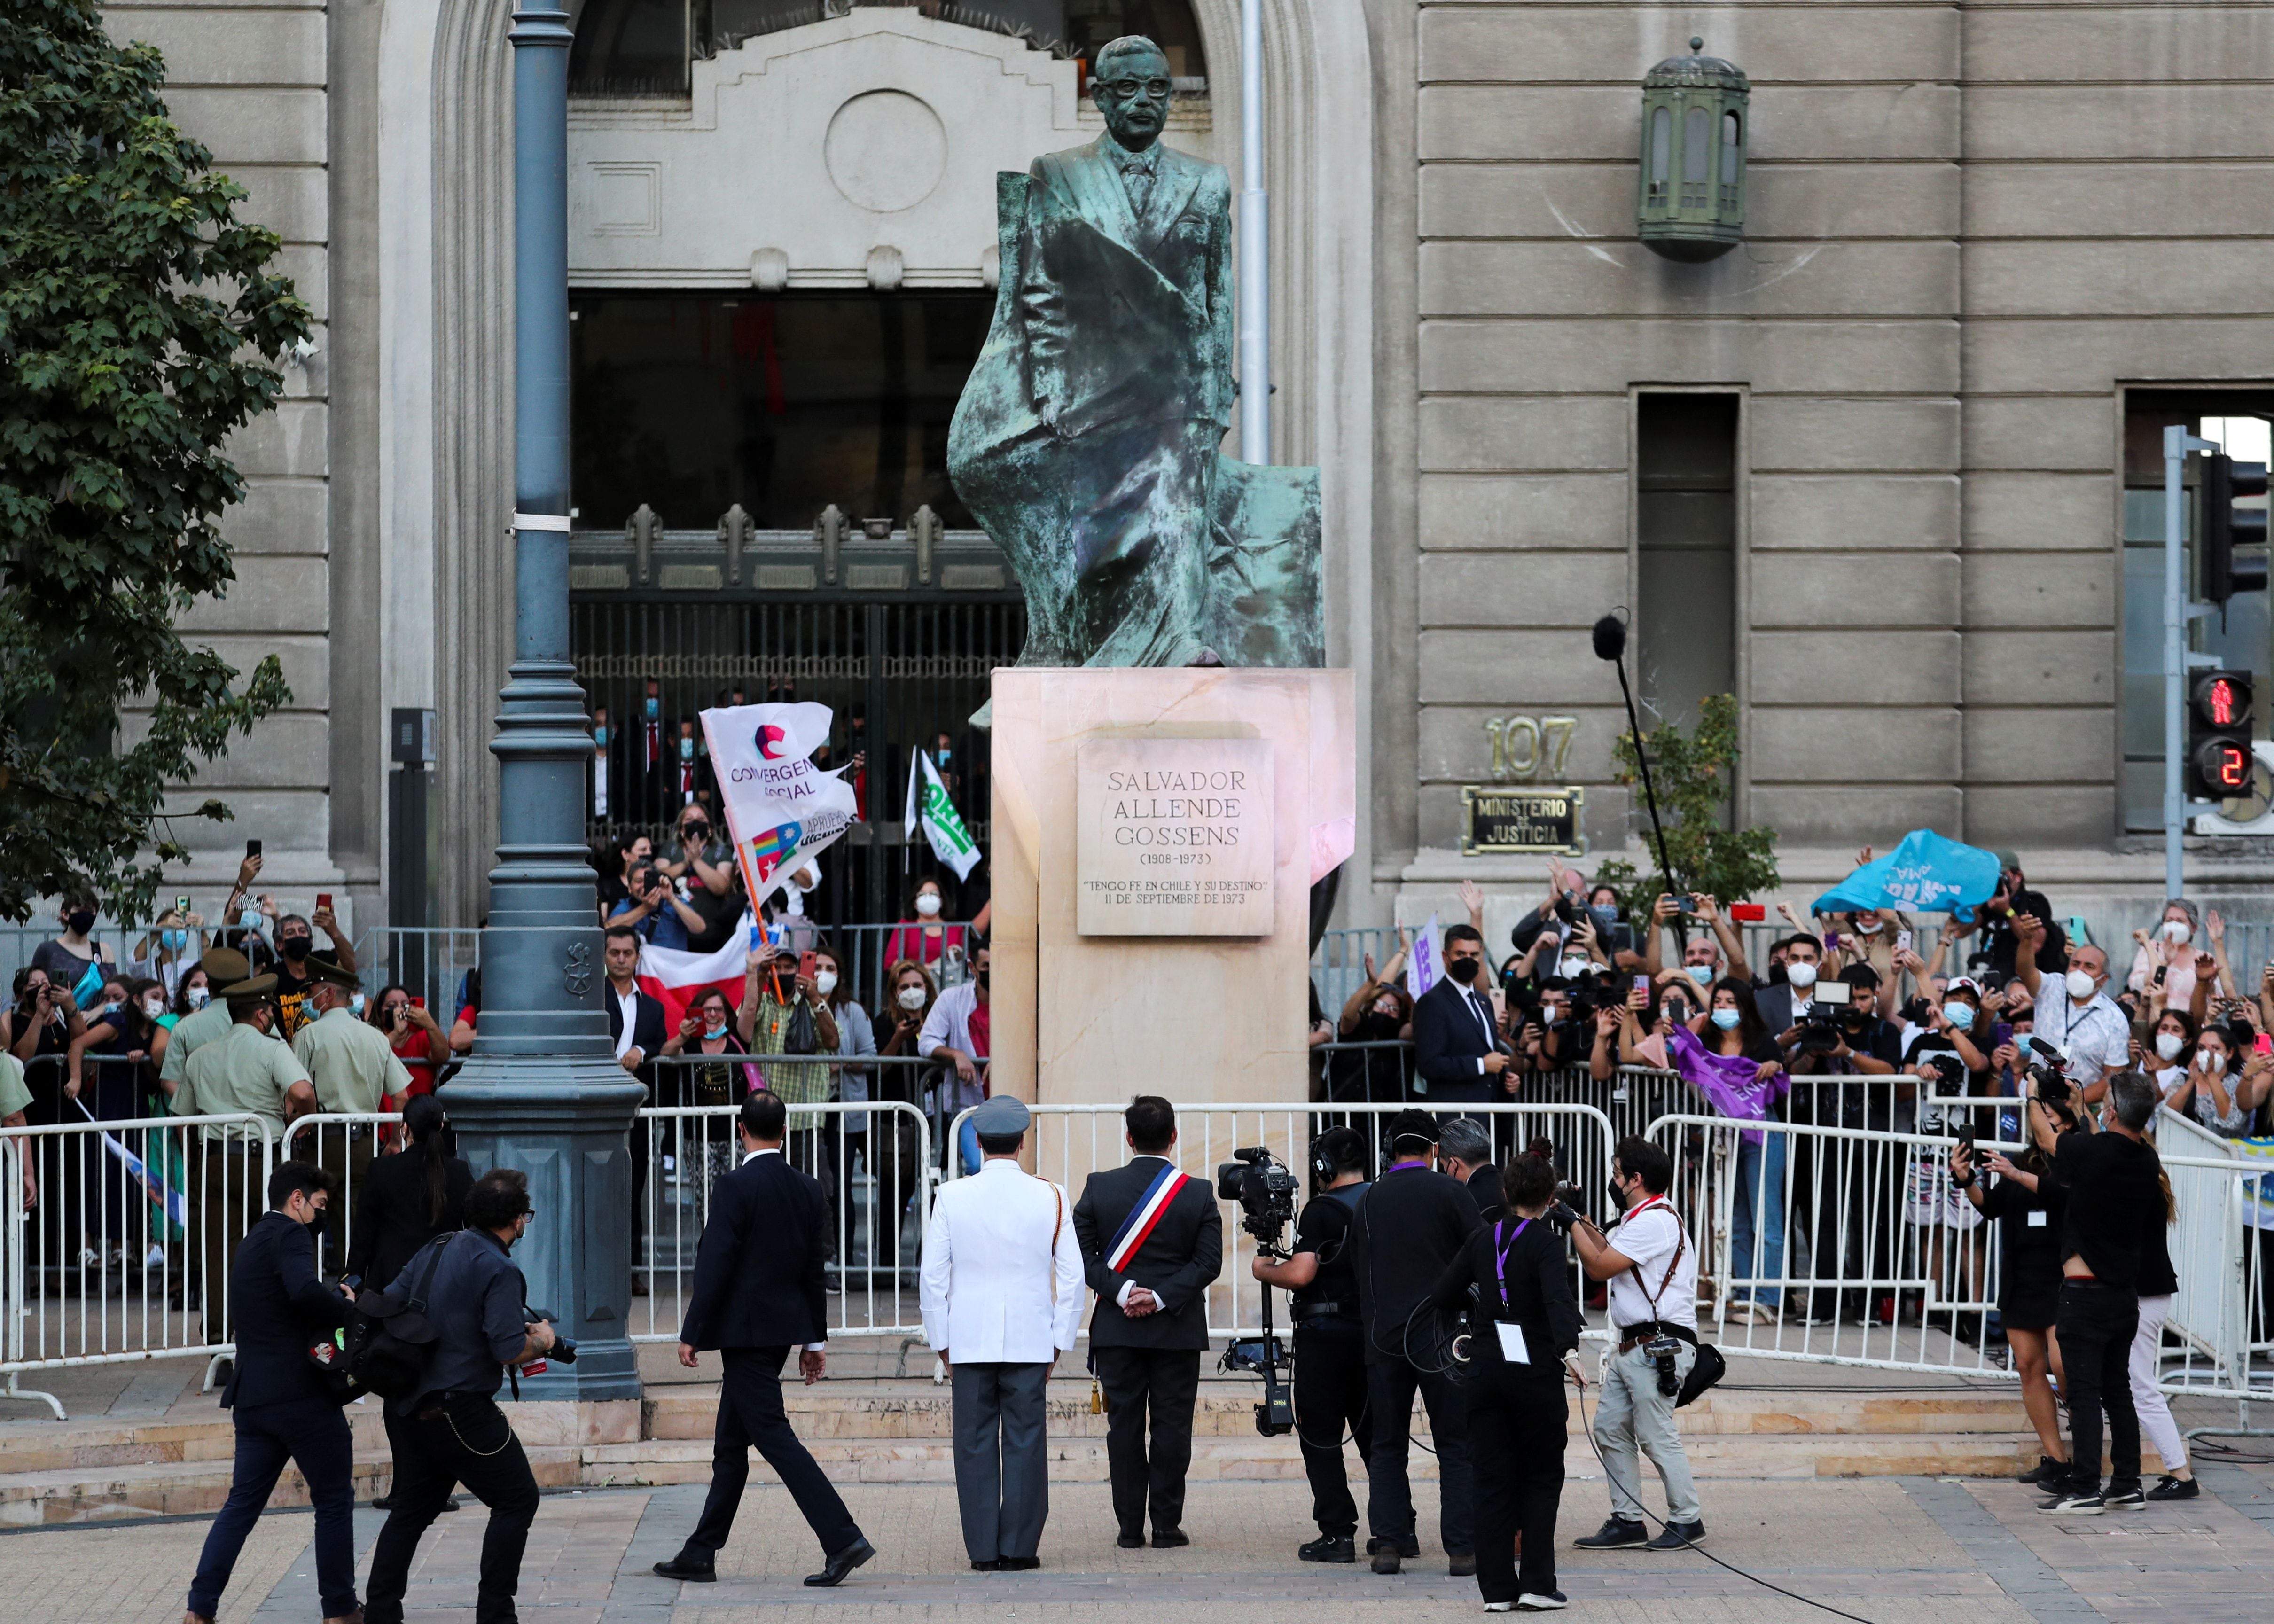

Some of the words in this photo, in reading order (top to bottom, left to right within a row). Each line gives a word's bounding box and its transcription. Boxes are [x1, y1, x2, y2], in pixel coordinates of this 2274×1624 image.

[1484, 716, 1577, 778] 107
[2221, 750, 2243, 785] 2
[1108, 771, 1246, 791] SALVADOR
[1114, 799, 1241, 819] ALLENDE
[1477, 798, 1567, 817] MINISTERIO
[1115, 827, 1239, 845] GOSSENS
[1487, 825, 1559, 843] JUSTICIA
[1140, 854, 1211, 865] (1908-1973)
[1130, 882, 1142, 890] FE
[1146, 882, 1157, 890] EN
[1161, 882, 1192, 890] CHILE
[1193, 882, 1202, 890] Y
[1205, 882, 1217, 890] SU
[1117, 895, 1131, 904] DE
[1137, 894, 1200, 904] SEPTIEMBRE
[1204, 895, 1219, 904] DE
[1222, 895, 1245, 904] 1973
[1316, 1159, 1324, 1171] 8
